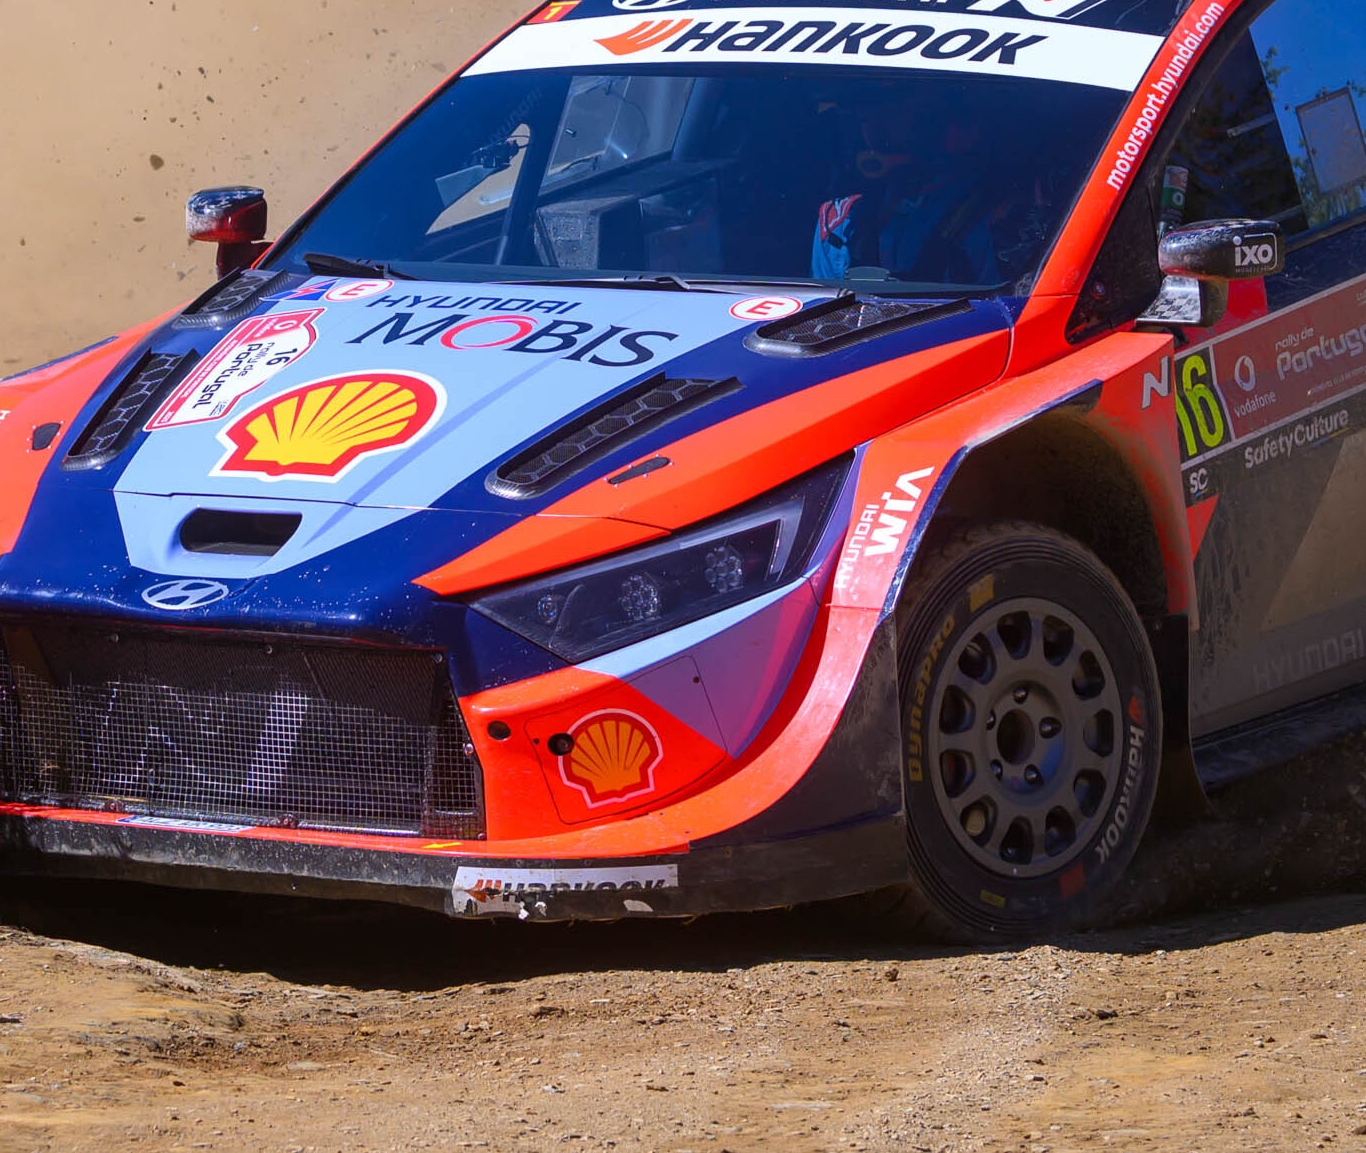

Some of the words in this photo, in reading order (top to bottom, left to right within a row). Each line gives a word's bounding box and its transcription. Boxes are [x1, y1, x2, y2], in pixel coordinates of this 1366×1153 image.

[544, 4, 564, 21] 1
[1106, 1, 1225, 190] motorsport.hyundai.com
[1232, 235, 1273, 266] ixo
[339, 283, 378, 297] E
[366, 295, 583, 314] HYUNDAI
[746, 299, 787, 316] E
[247, 342, 275, 365] rally
[346, 312, 678, 367] MOBIS
[1274, 332, 1300, 351] rally
[1300, 326, 1315, 340] de
[237, 363, 254, 377] de
[266, 347, 298, 366] 16
[191, 344, 263, 409] Portugal
[1141, 355, 1172, 410] N
[1175, 354, 1225, 457] 16
[1234, 389, 1277, 419] vodafone
[1244, 408, 1349, 469] SafetyCulture
[1189, 467, 1209, 494] SC
[863, 466, 935, 557] WIA
[835, 503, 881, 589] HYUNDAI
